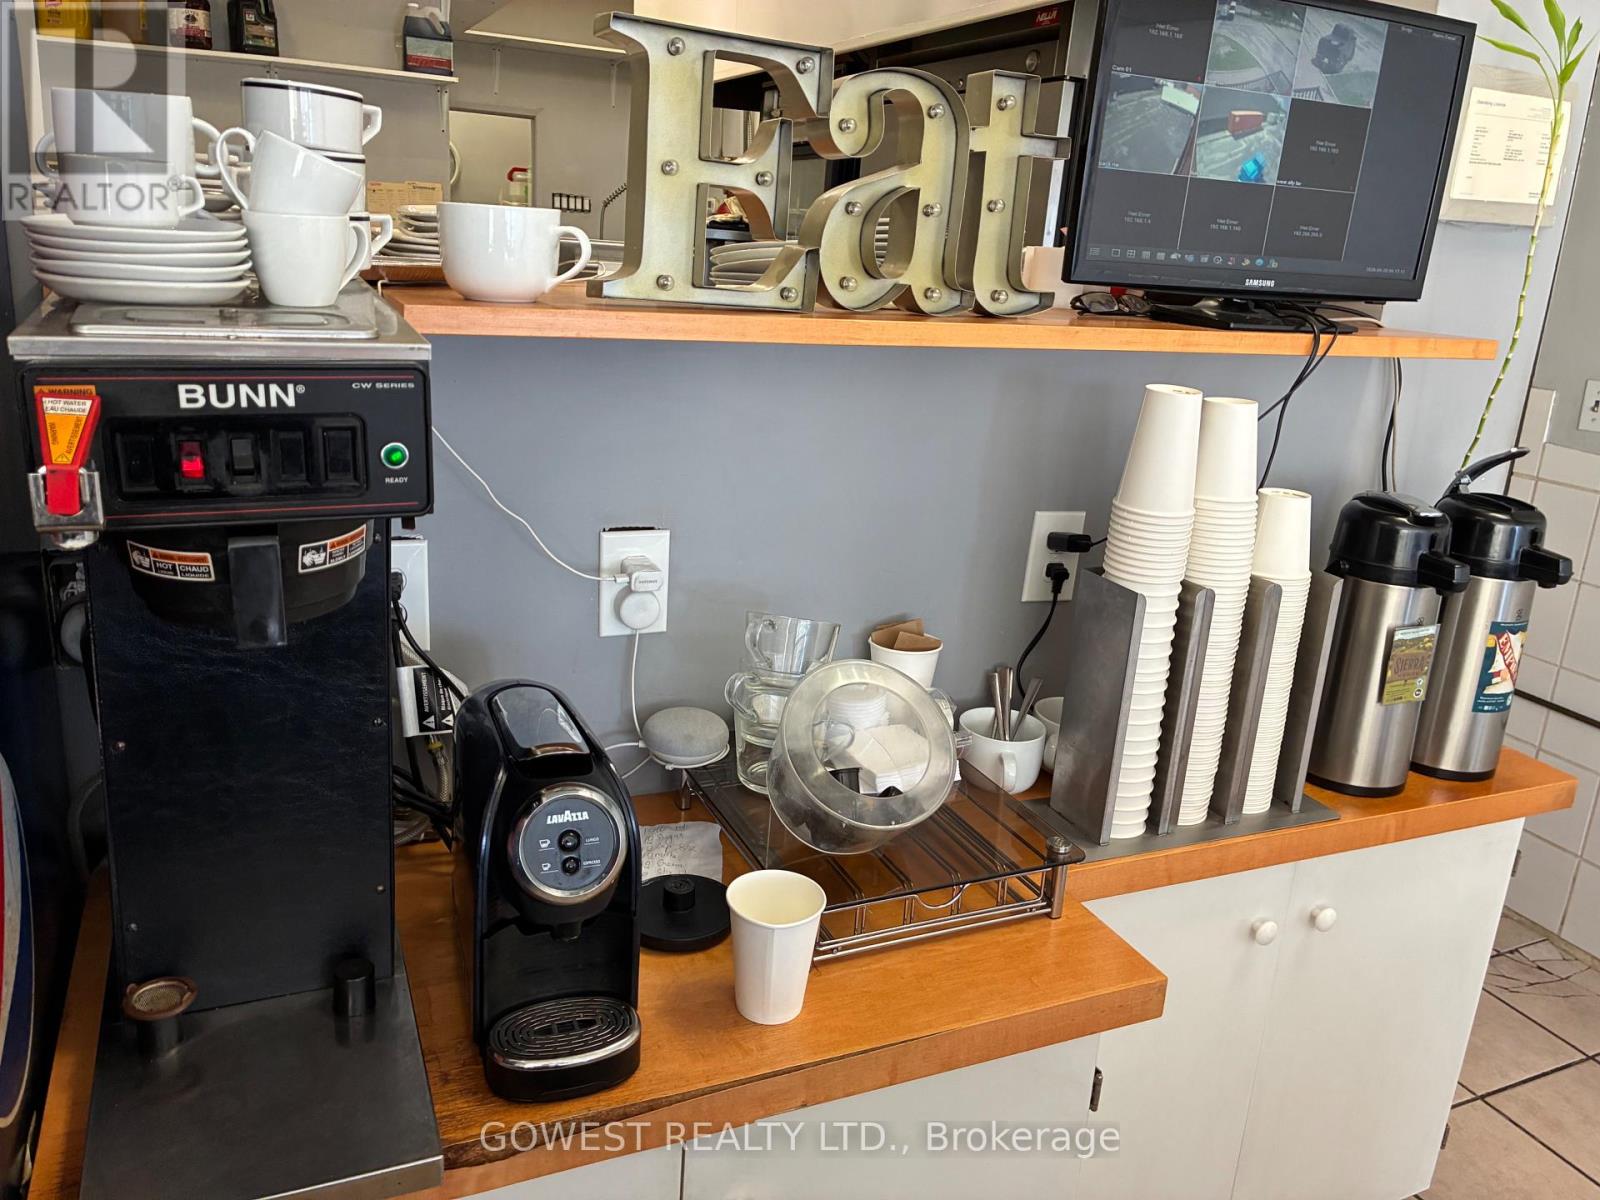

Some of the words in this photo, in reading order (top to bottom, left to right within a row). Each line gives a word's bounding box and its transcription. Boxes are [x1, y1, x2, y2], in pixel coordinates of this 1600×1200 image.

[587, 11, 1070, 317] Eat
[1244, 278, 1275, 287] SAMSUNG
[384, 476, 409, 484] READY
[156, 562, 173, 571] HOT
[179, 565, 209, 573] CHAUD
[1394, 655, 1425, 673] SIERRA
